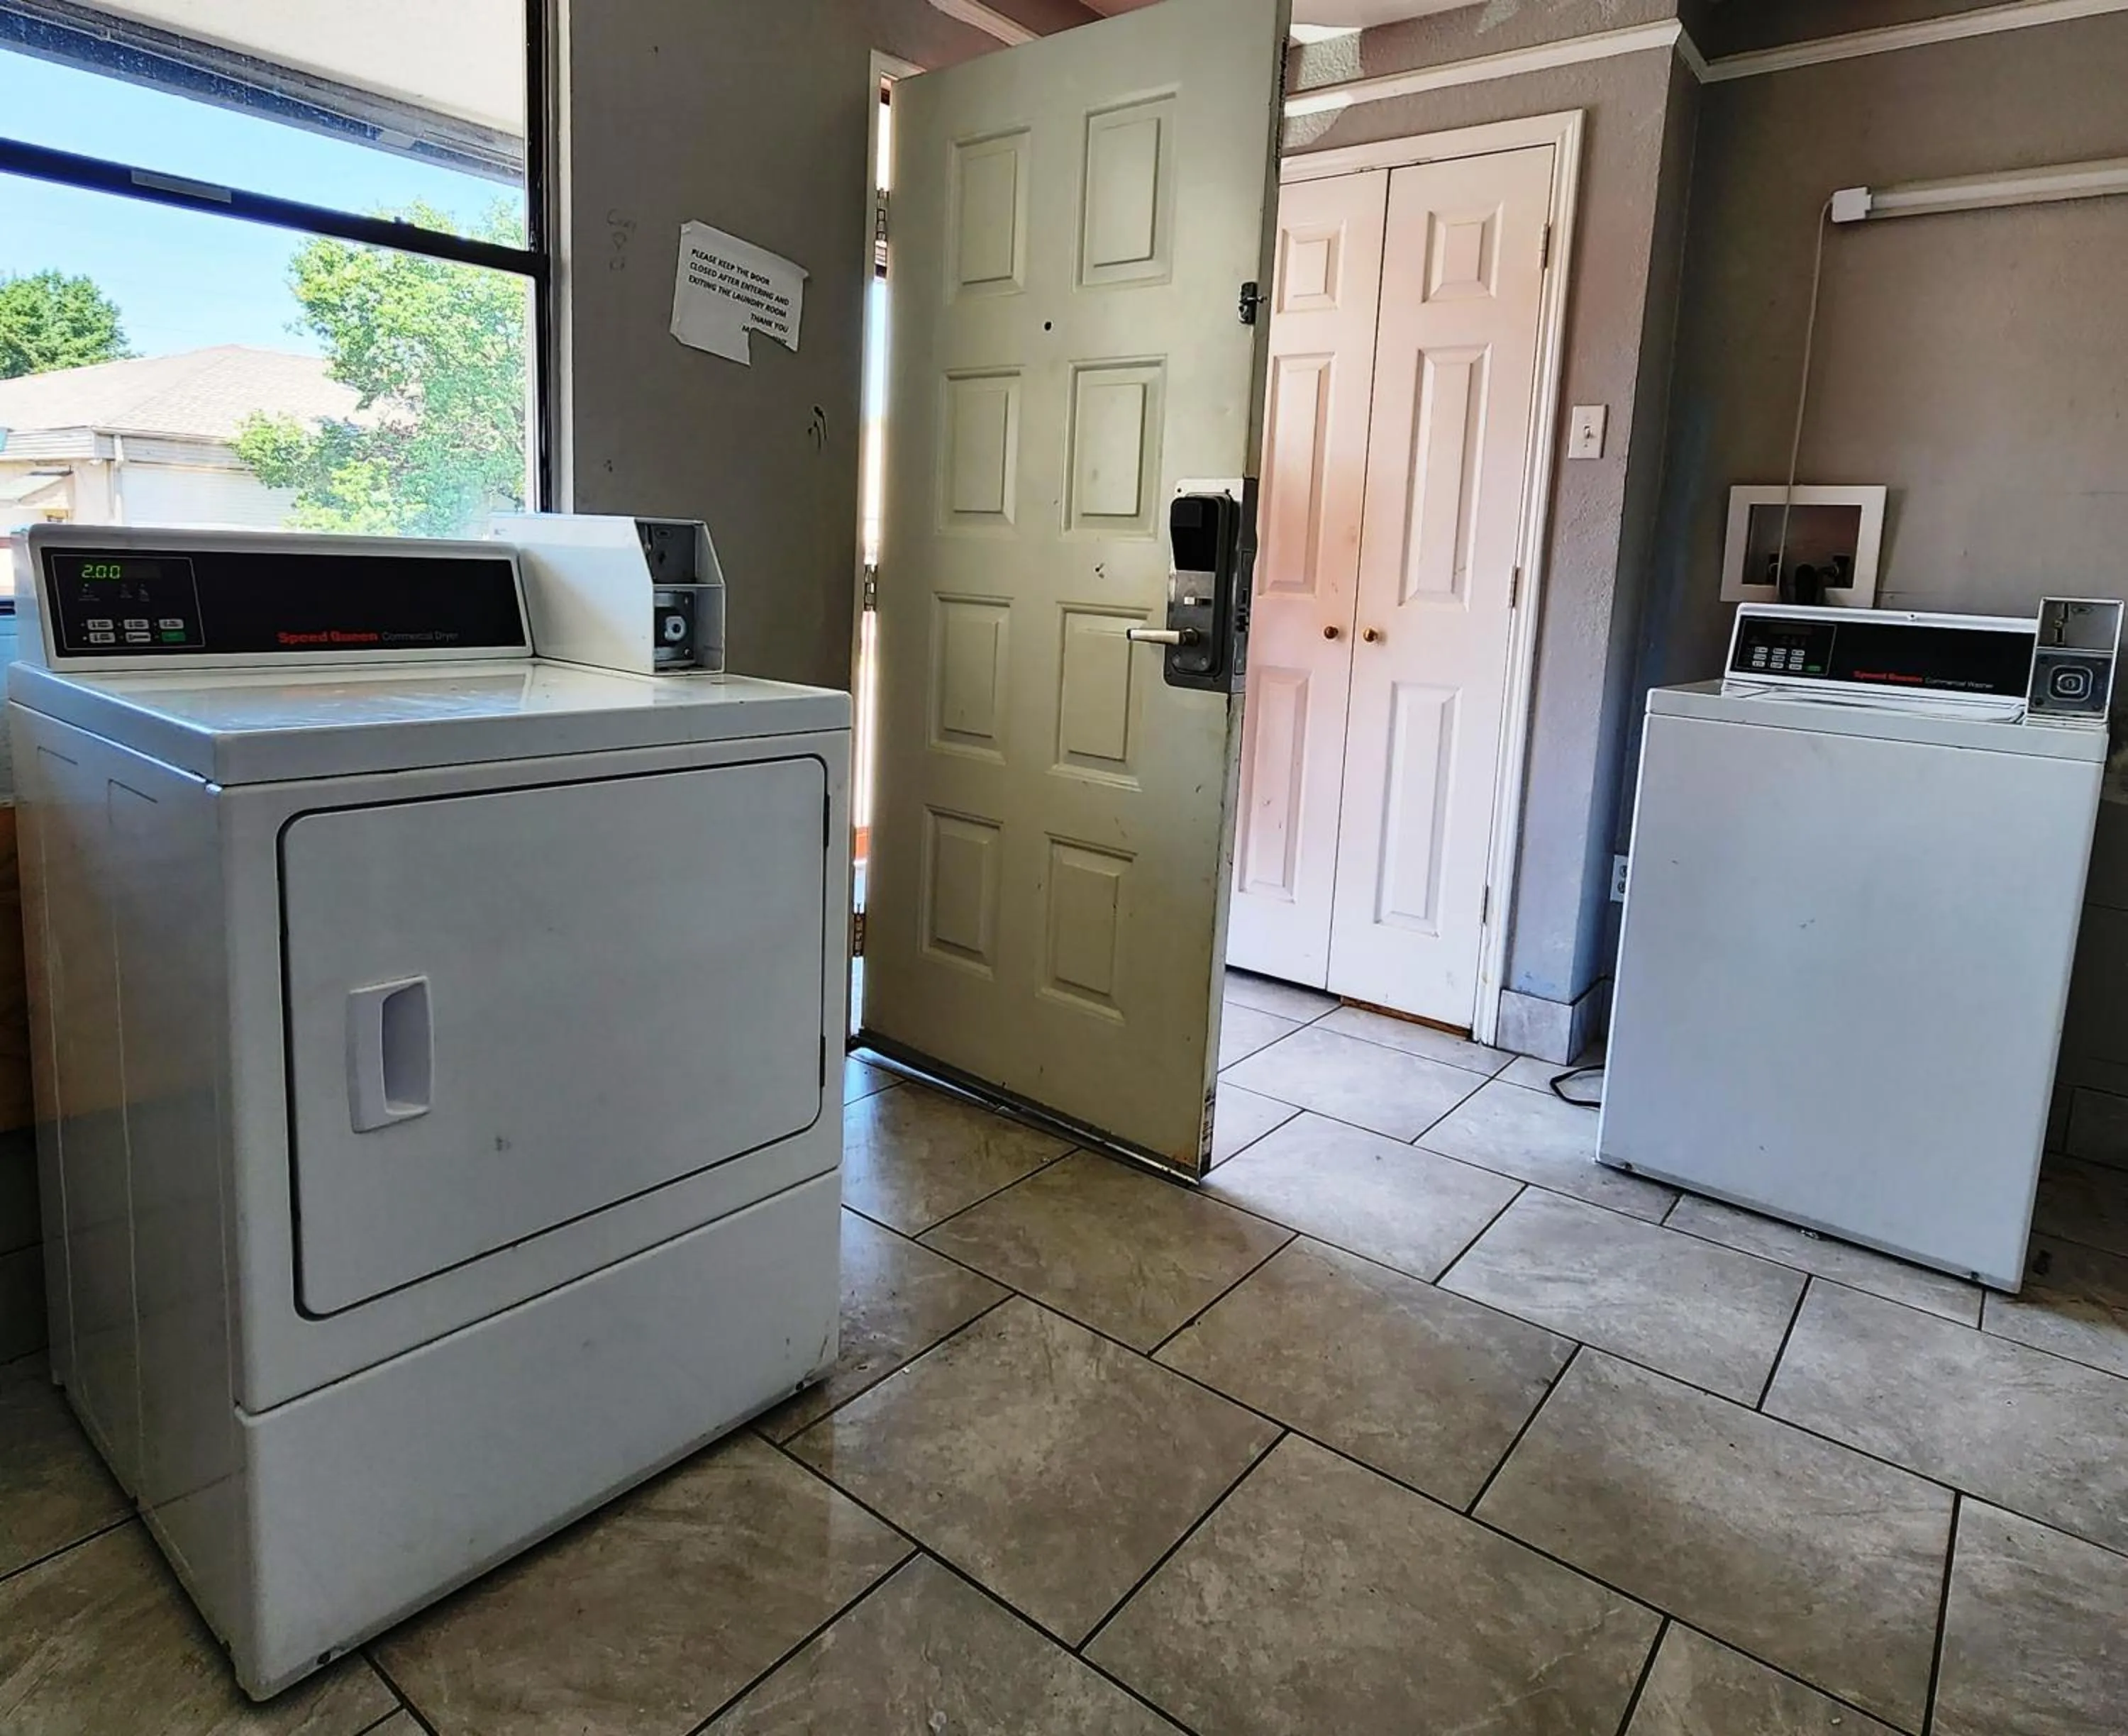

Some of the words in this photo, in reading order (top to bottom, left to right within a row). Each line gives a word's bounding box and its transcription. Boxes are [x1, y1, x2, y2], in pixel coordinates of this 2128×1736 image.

[692, 249, 716, 265] PLEASE
[718, 259, 735, 270] KEEP
[737, 266, 749, 277] THE
[750, 272, 770, 285] DOOR
[689, 274, 717, 291] EXITING
[719, 286, 731, 298] THE
[732, 291, 764, 309] LAUNDRY
[765, 304, 786, 318] ROOM
[690, 262, 717, 277] CLOSED
[718, 273, 739, 286] AFTER
[741, 282, 774, 300] ENTERING
[775, 295, 789, 306] AND
[750, 313, 772, 328] THANK
[775, 322, 789, 333] YOU
[82, 564, 121, 579] 2.00
[277, 632, 327, 644] Speed
[331, 630, 378, 642] Queen
